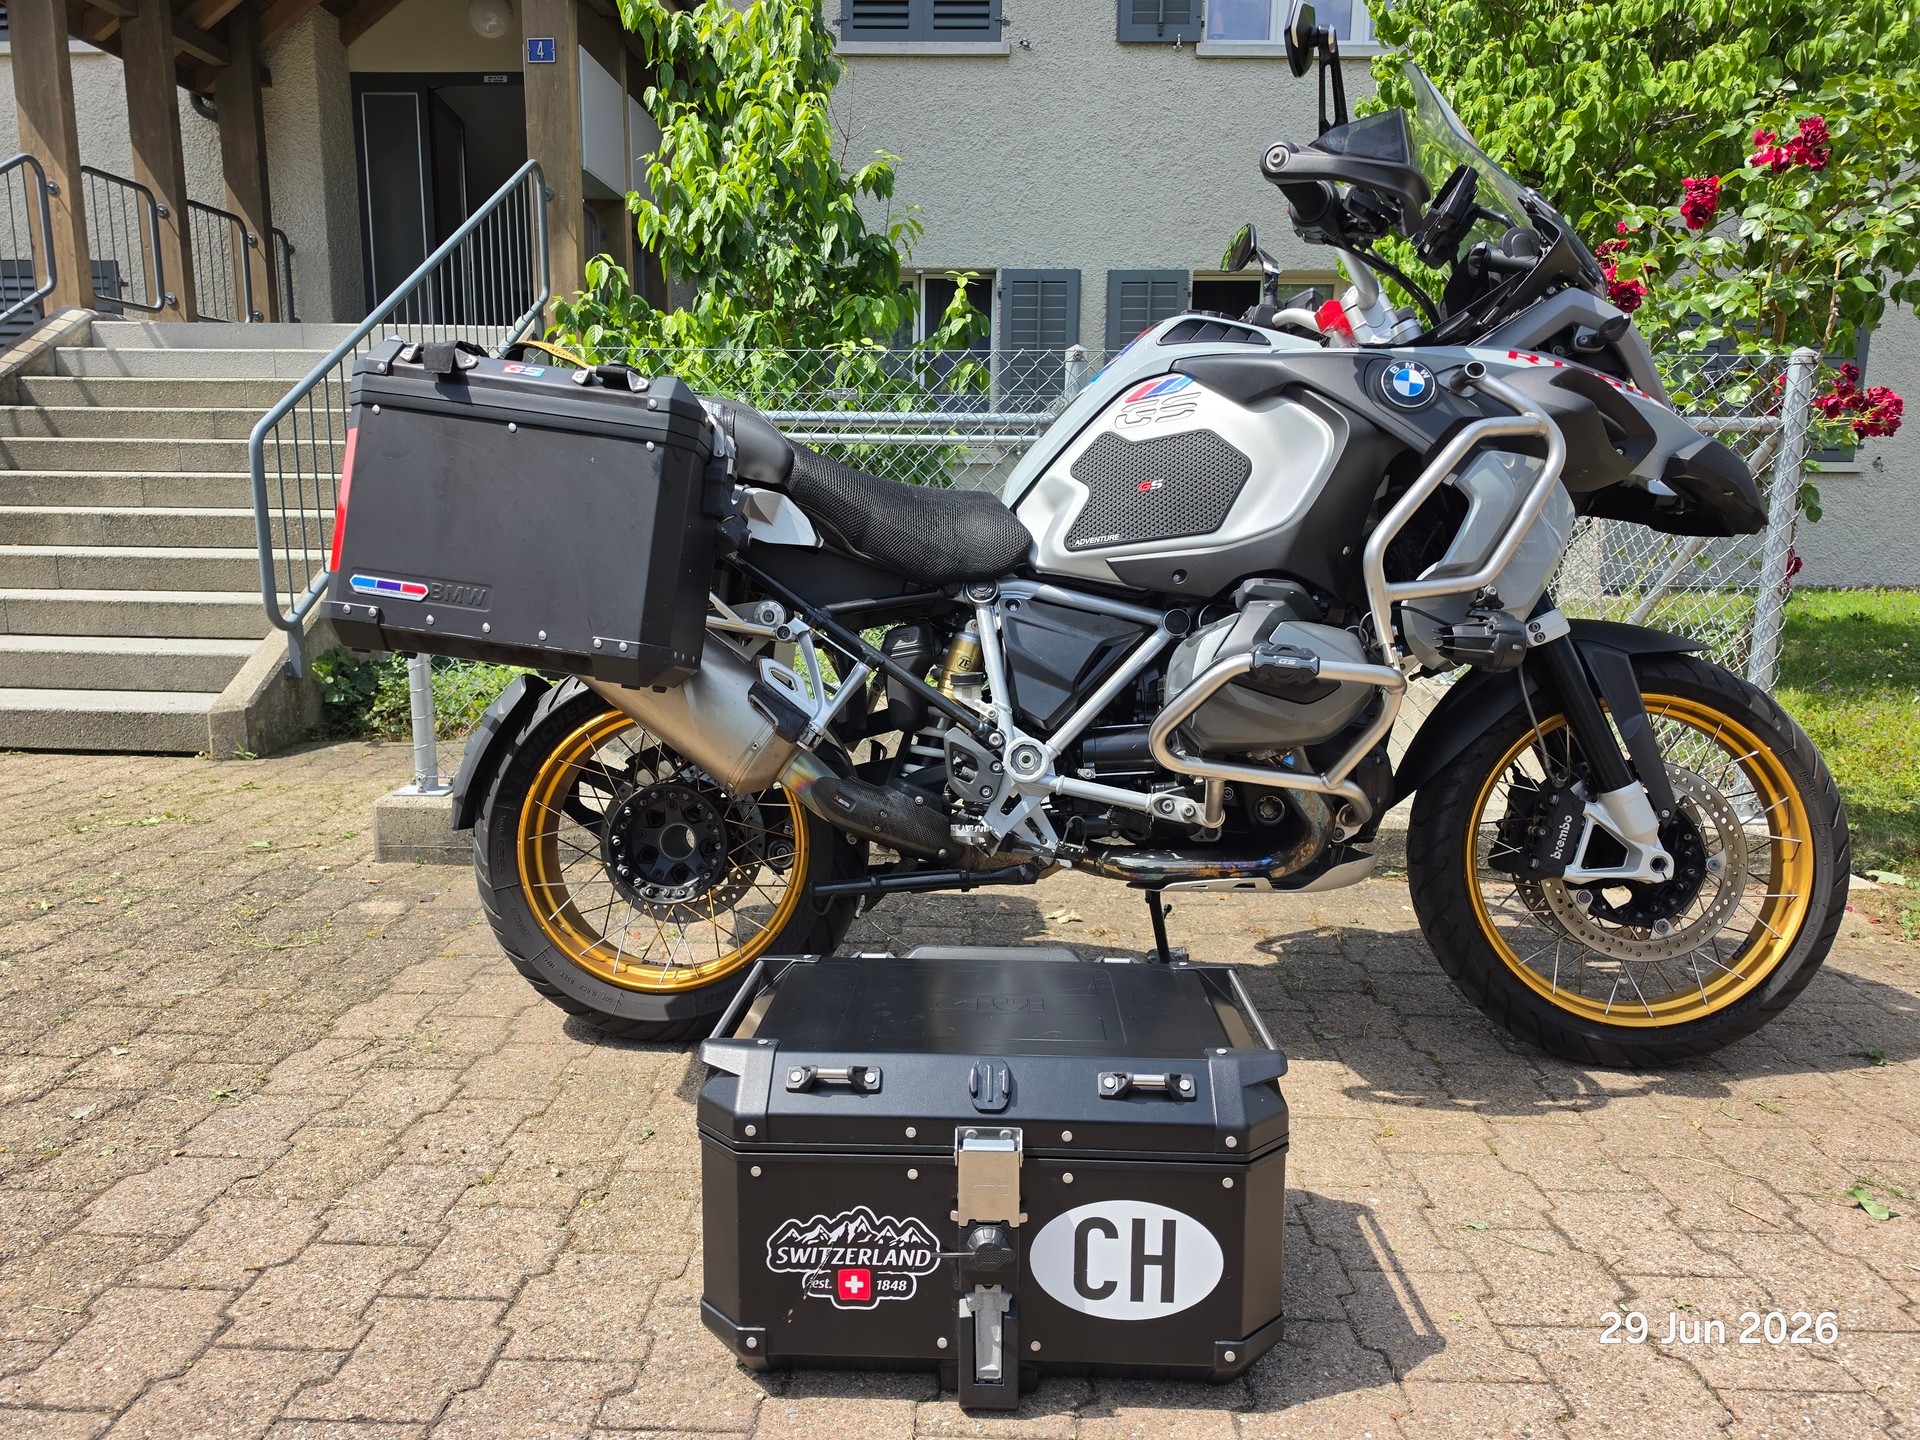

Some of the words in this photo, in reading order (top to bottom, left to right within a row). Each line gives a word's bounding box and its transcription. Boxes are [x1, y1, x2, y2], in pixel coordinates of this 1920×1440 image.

[537, 41, 544, 59] 4
[1389, 362, 1430, 379] BMW
[1115, 392, 1201, 429] GS
[1138, 479, 1164, 492] GS
[1075, 534, 1120, 546] ADVENTURE
[431, 582, 487, 607] BMW
[958, 659, 972, 671] ZF
[1550, 815, 1573, 860] brembo
[776, 1246, 932, 1267] SWITZERLAND
[1073, 1217, 1178, 1304] CH
[813, 1278, 832, 1289] est.
[876, 1279, 907, 1291] 1848
